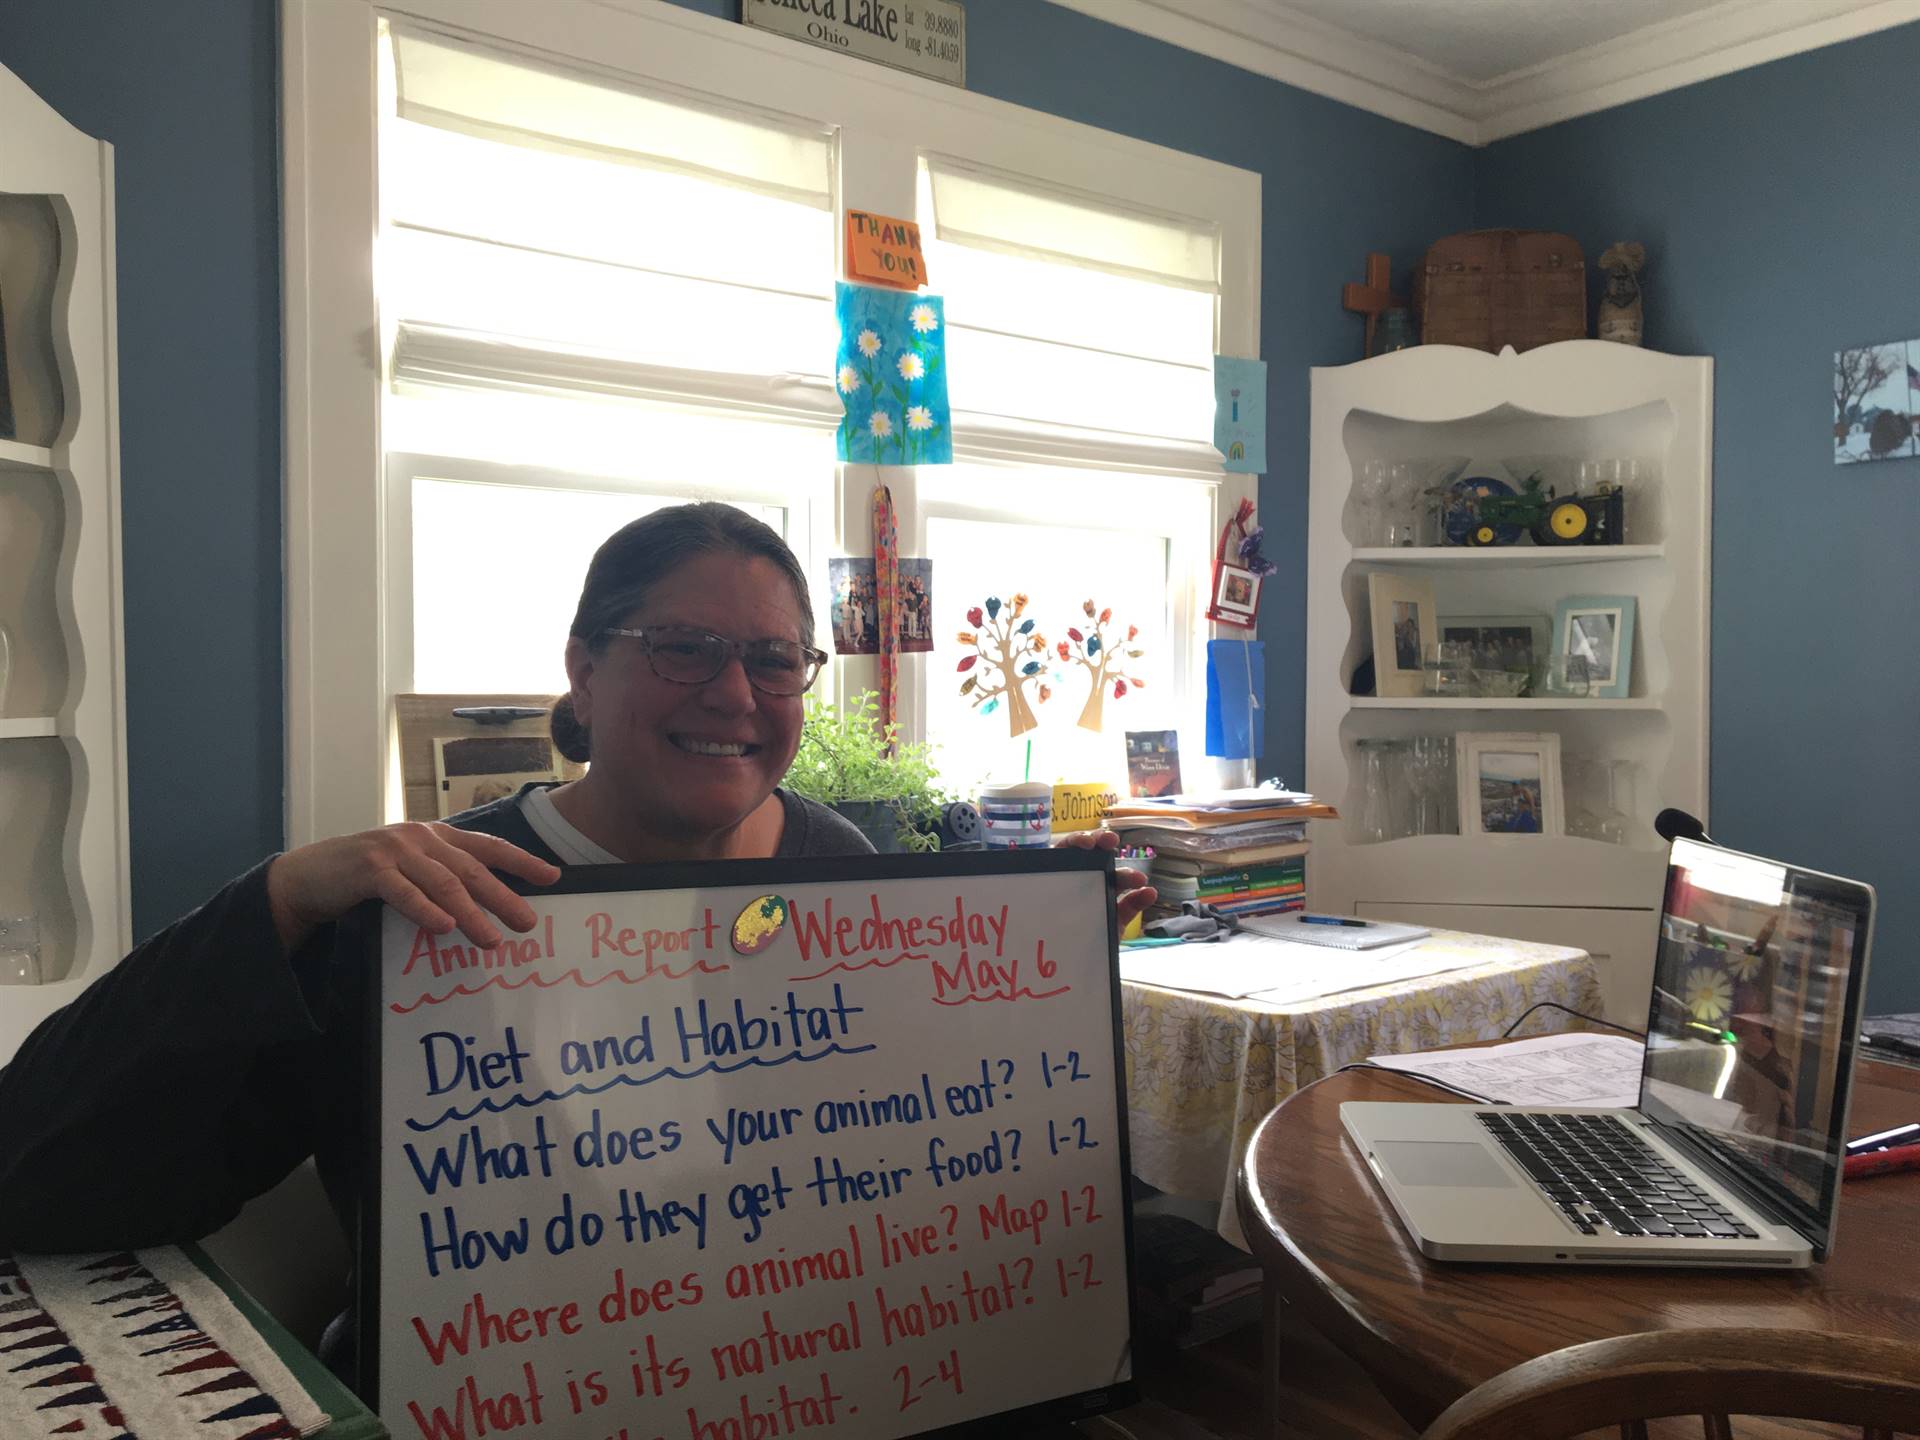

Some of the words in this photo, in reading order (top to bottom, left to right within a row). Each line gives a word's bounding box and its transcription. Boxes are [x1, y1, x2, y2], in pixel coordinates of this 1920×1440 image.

[806, 22, 849, 48] Ohio
[843, 0, 898, 42] Lake
[904, 29, 921, 56] long
[851, 213, 922, 253] THANK
[871, 247, 917, 281] YOU!
[1062, 792, 1119, 821] Johnson
[401, 914, 555, 978] Animal
[584, 907, 722, 974] Report
[788, 894, 1008, 962] Wednesday
[931, 951, 1018, 1000] May
[1036, 939, 1057, 978] 6
[419, 1026, 531, 1096] Diet
[560, 1015, 656, 1075] and
[674, 982, 864, 1063] Habitat
[402, 1115, 558, 1195] What
[573, 1108, 682, 1169] does
[706, 1107, 803, 1165] your
[814, 1073, 937, 1134] animal
[945, 1059, 1016, 1118] eat?
[1041, 1051, 1091, 1089] 1-2
[419, 1205, 529, 1278] How
[545, 1192, 605, 1256] do
[615, 1188, 707, 1251] they
[728, 1166, 793, 1244] get
[805, 1156, 913, 1208] their
[925, 1129, 1022, 1188] food?
[1048, 1117, 1099, 1156] 1-2
[411, 1292, 584, 1367] Where
[598, 1267, 704, 1325] does
[725, 1225, 865, 1299] animal
[875, 1204, 959, 1269] live?
[978, 1193, 1049, 1246] Map
[1061, 1184, 1103, 1228] 1-2
[406, 1361, 544, 1440] What
[565, 1369, 609, 1415] is
[629, 1333, 691, 1397] its
[710, 1300, 862, 1381] natural
[874, 1256, 1035, 1347] habitat?
[1056, 1253, 1104, 1299] 1-2
[687, 1372, 859, 1440] habitat.
[892, 1349, 964, 1413] 2-4
